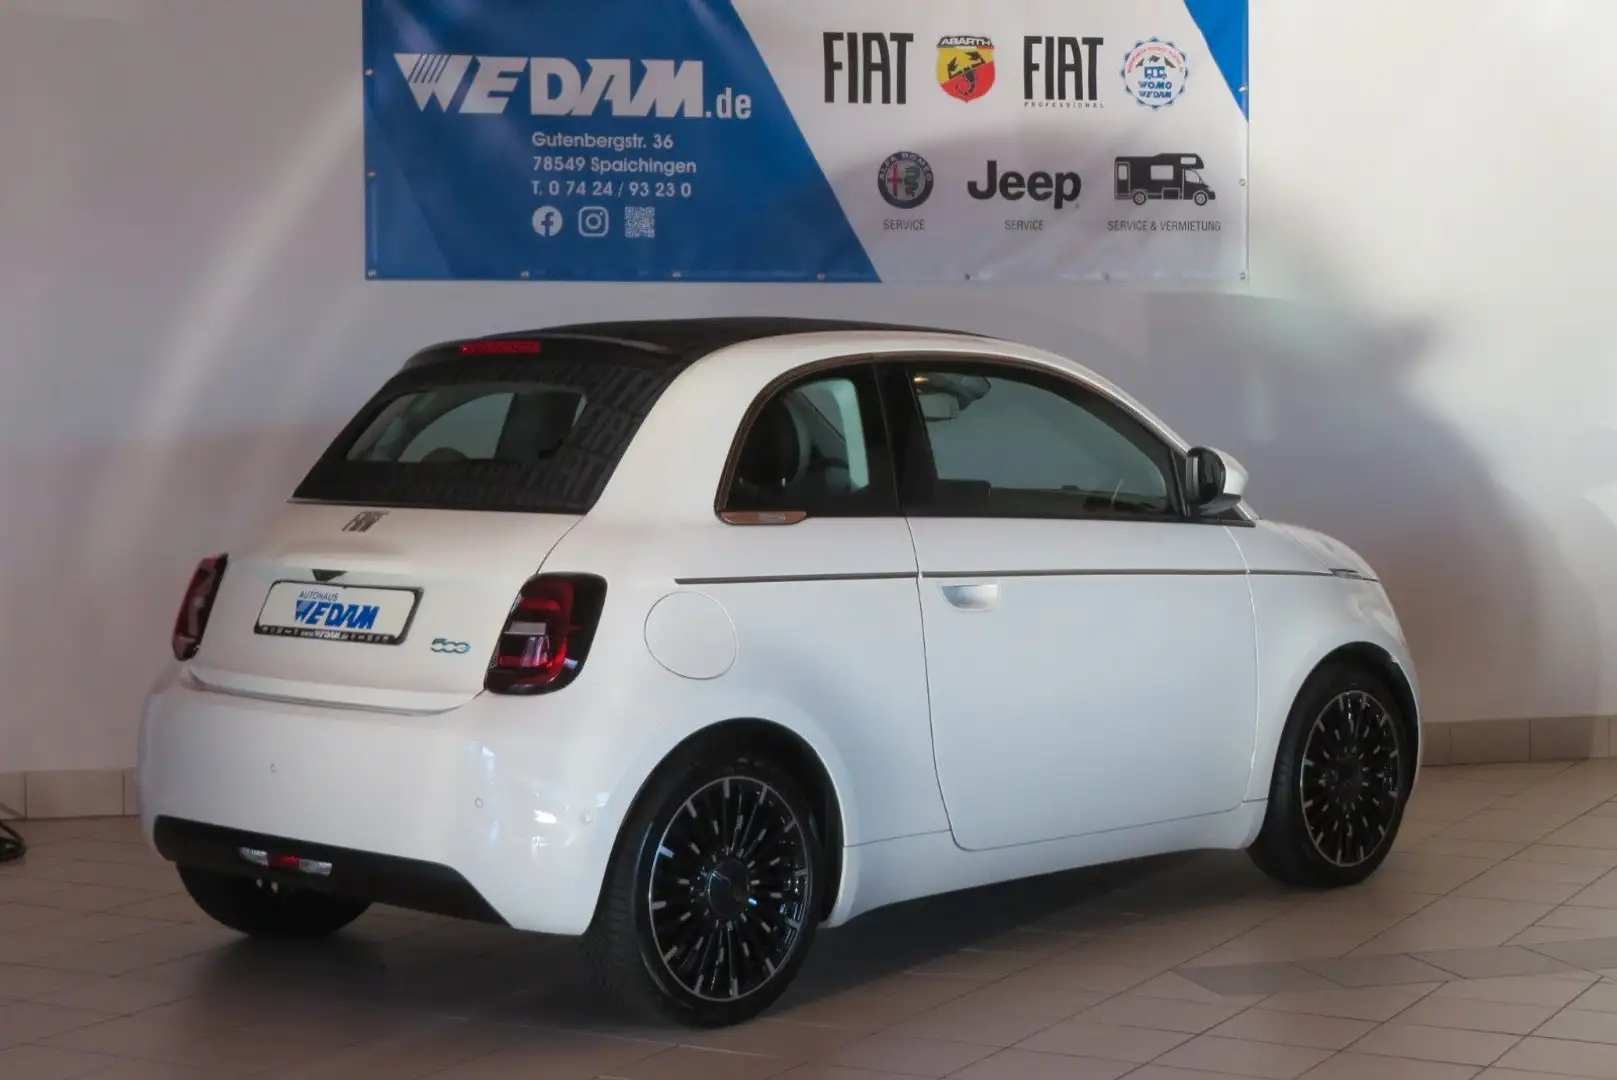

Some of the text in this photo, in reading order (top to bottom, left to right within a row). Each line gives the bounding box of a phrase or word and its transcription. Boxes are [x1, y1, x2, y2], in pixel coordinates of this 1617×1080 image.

[940, 37, 992, 46] ABARTH
[823, 32, 914, 104] FIAT
[1023, 36, 1104, 101] FIAT
[1138, 81, 1173, 90] WOMO
[1138, 90, 1172, 99] WEDAM
[1023, 101, 1105, 109] PROFESSIONAL
[531, 131, 674, 152] Gutenbergstr. 36
[533, 155, 697, 177] 78549 Spaichingen
[531, 180, 543, 196] T.
[549, 180, 560, 196] 0
[566, 181, 587, 196] 74
[592, 181, 613, 196] 24
[629, 182, 649, 197] 93
[655, 182, 675, 197] 23
[681, 182, 692, 197] 0
[967, 160, 1082, 209] Jeep
[883, 219, 925, 231] SERVICE
[1004, 219, 1044, 231] SERVICE
[1107, 220, 1222, 232] SERVICE & VERMIETUNG
[298, 590, 339, 601] AUTOHAUS
[295, 600, 380, 630] WEDAM
[430, 637, 471, 654] 500
